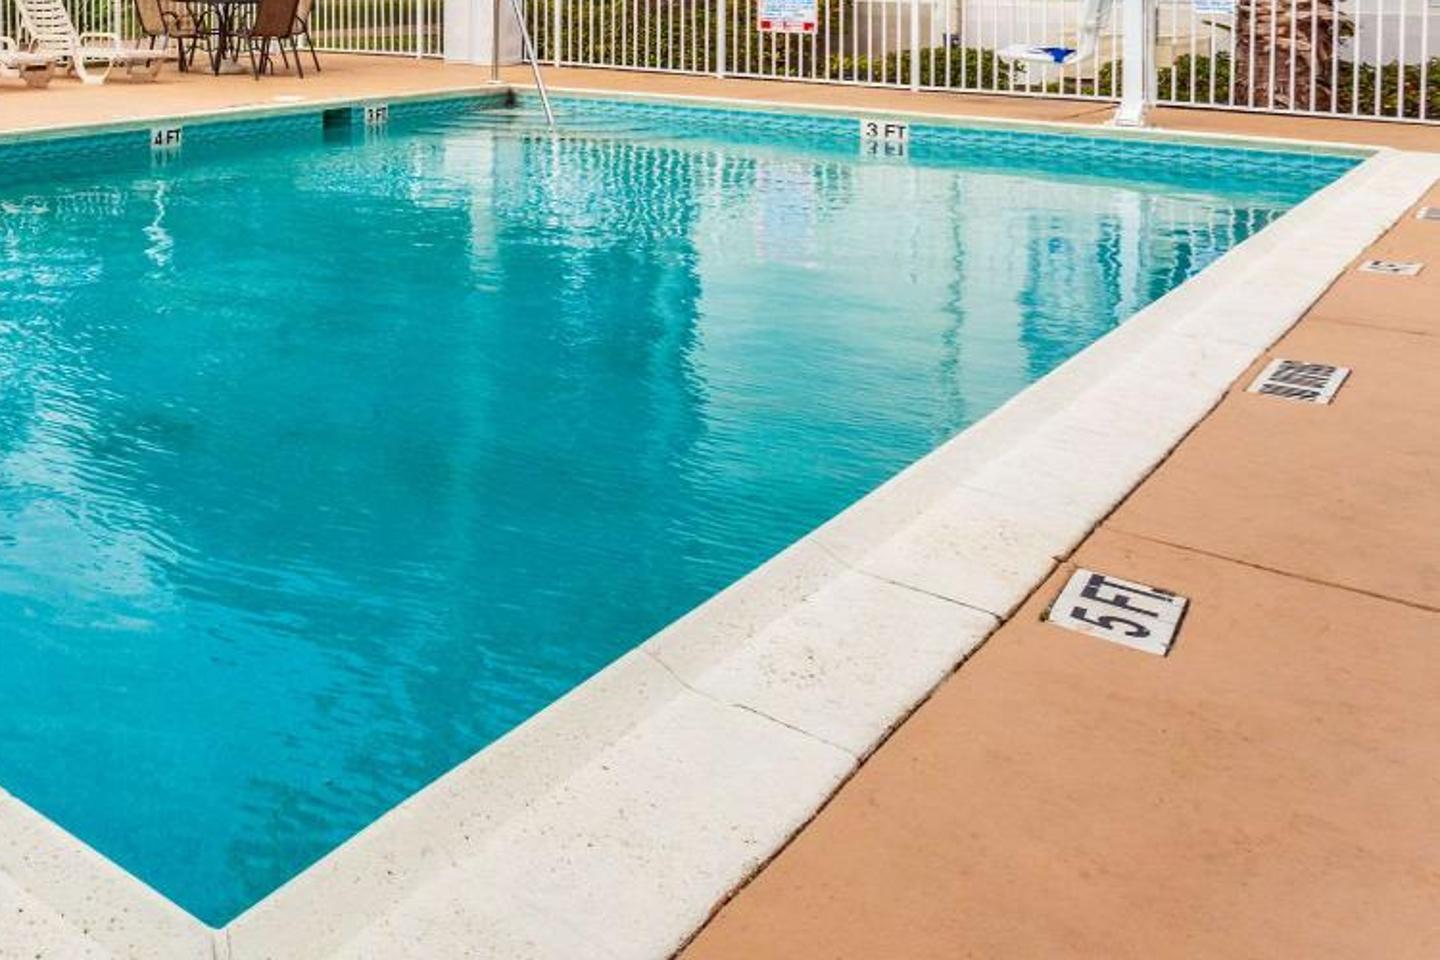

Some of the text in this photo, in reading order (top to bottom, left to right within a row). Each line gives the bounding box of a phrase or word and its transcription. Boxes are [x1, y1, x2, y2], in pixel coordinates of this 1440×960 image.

[154, 128, 181, 145] 4 FT
[865, 122, 907, 139] 3 FT
[1070, 606, 1151, 638] 5
